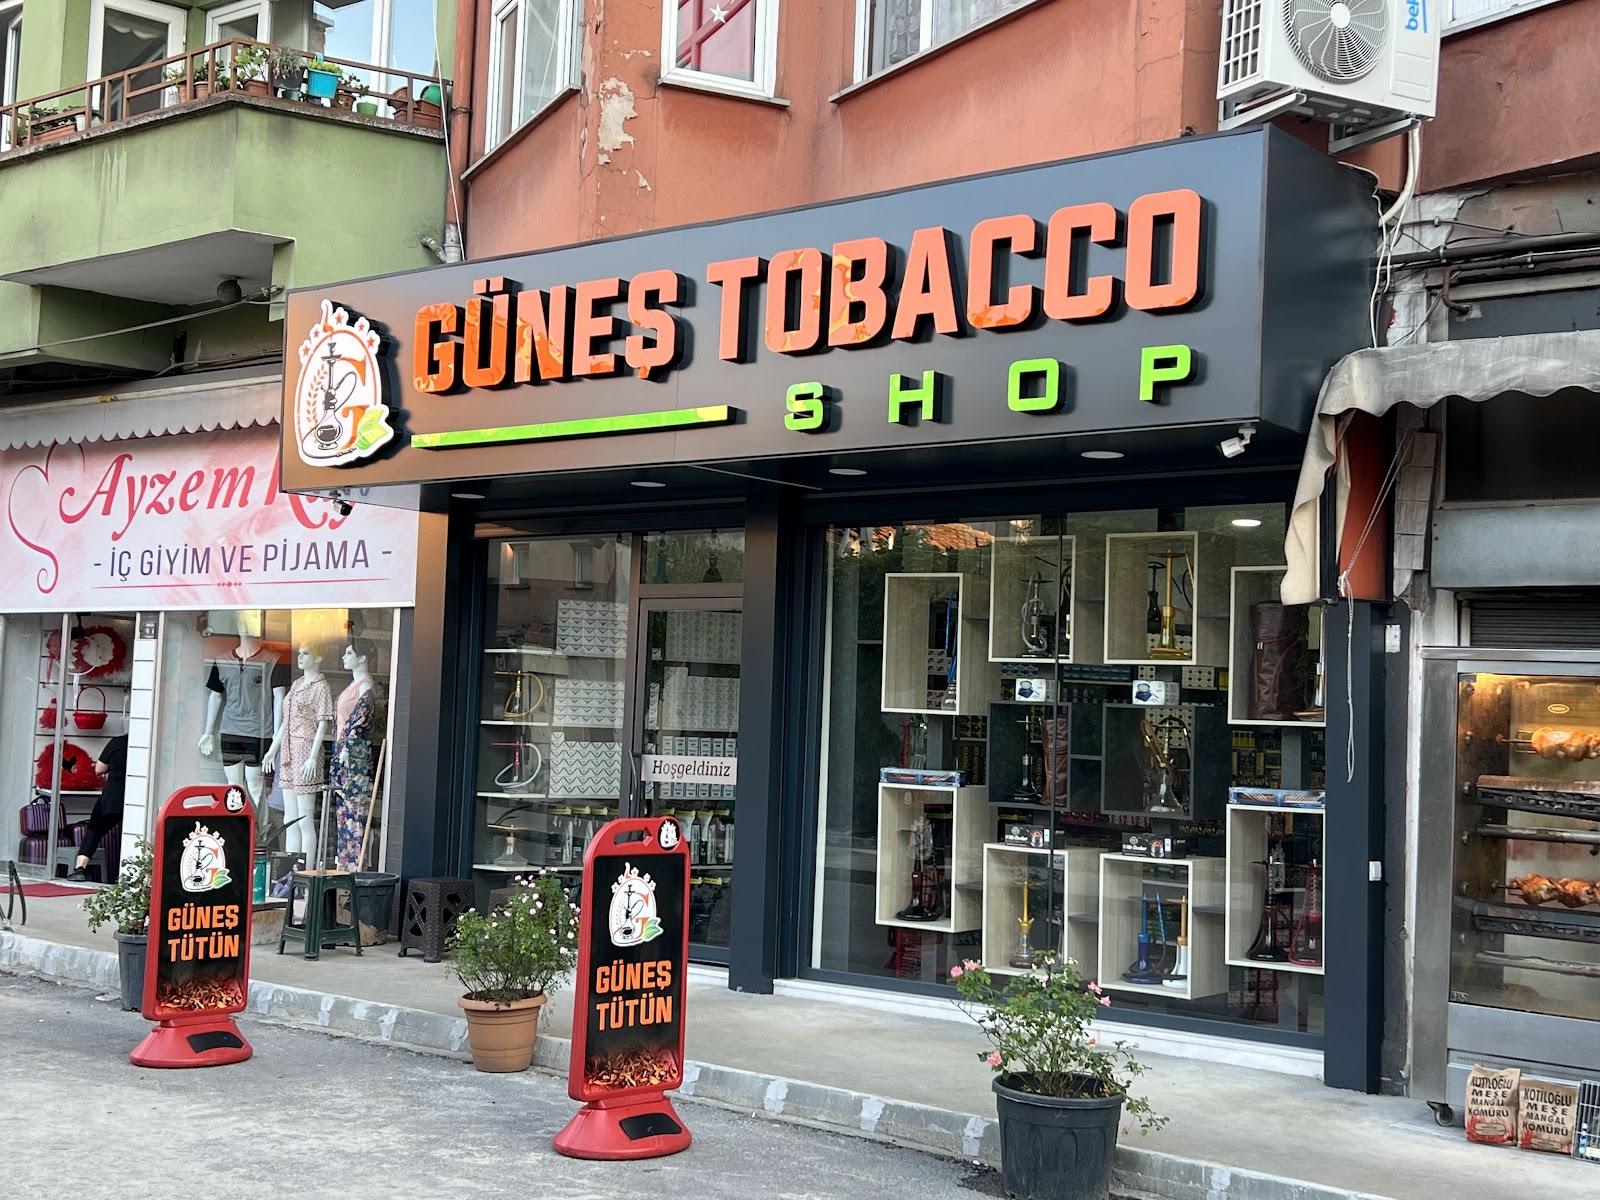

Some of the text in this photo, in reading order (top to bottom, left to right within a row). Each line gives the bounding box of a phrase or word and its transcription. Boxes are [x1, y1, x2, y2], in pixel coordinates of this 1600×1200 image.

[413, 188, 1203, 393] GÜNEŞ TOBACCO
[784, 344, 1193, 431] SHOP
[59, 453, 256, 541] Ayzem
[109, 546, 132, 582] İÇ
[139, 542, 211, 576] GİYİM
[220, 544, 254, 574] VE
[262, 538, 370, 572] PİJAMA
[652, 760, 731, 780] Hoşgeldiniz
[167, 902, 240, 931] GÜNEŞ
[167, 932, 240, 963] TÜTÜN
[595, 959, 673, 994] GÜNEŞ
[595, 991, 673, 1031] TÜTÜN
[1471, 1088, 1508, 1099] MEŞE
[1526, 1102, 1568, 1116] MEŞE
[1522, 1121, 1569, 1137] KÖMÜRÜ
[1525, 1112, 1566, 1125] MANGAL
